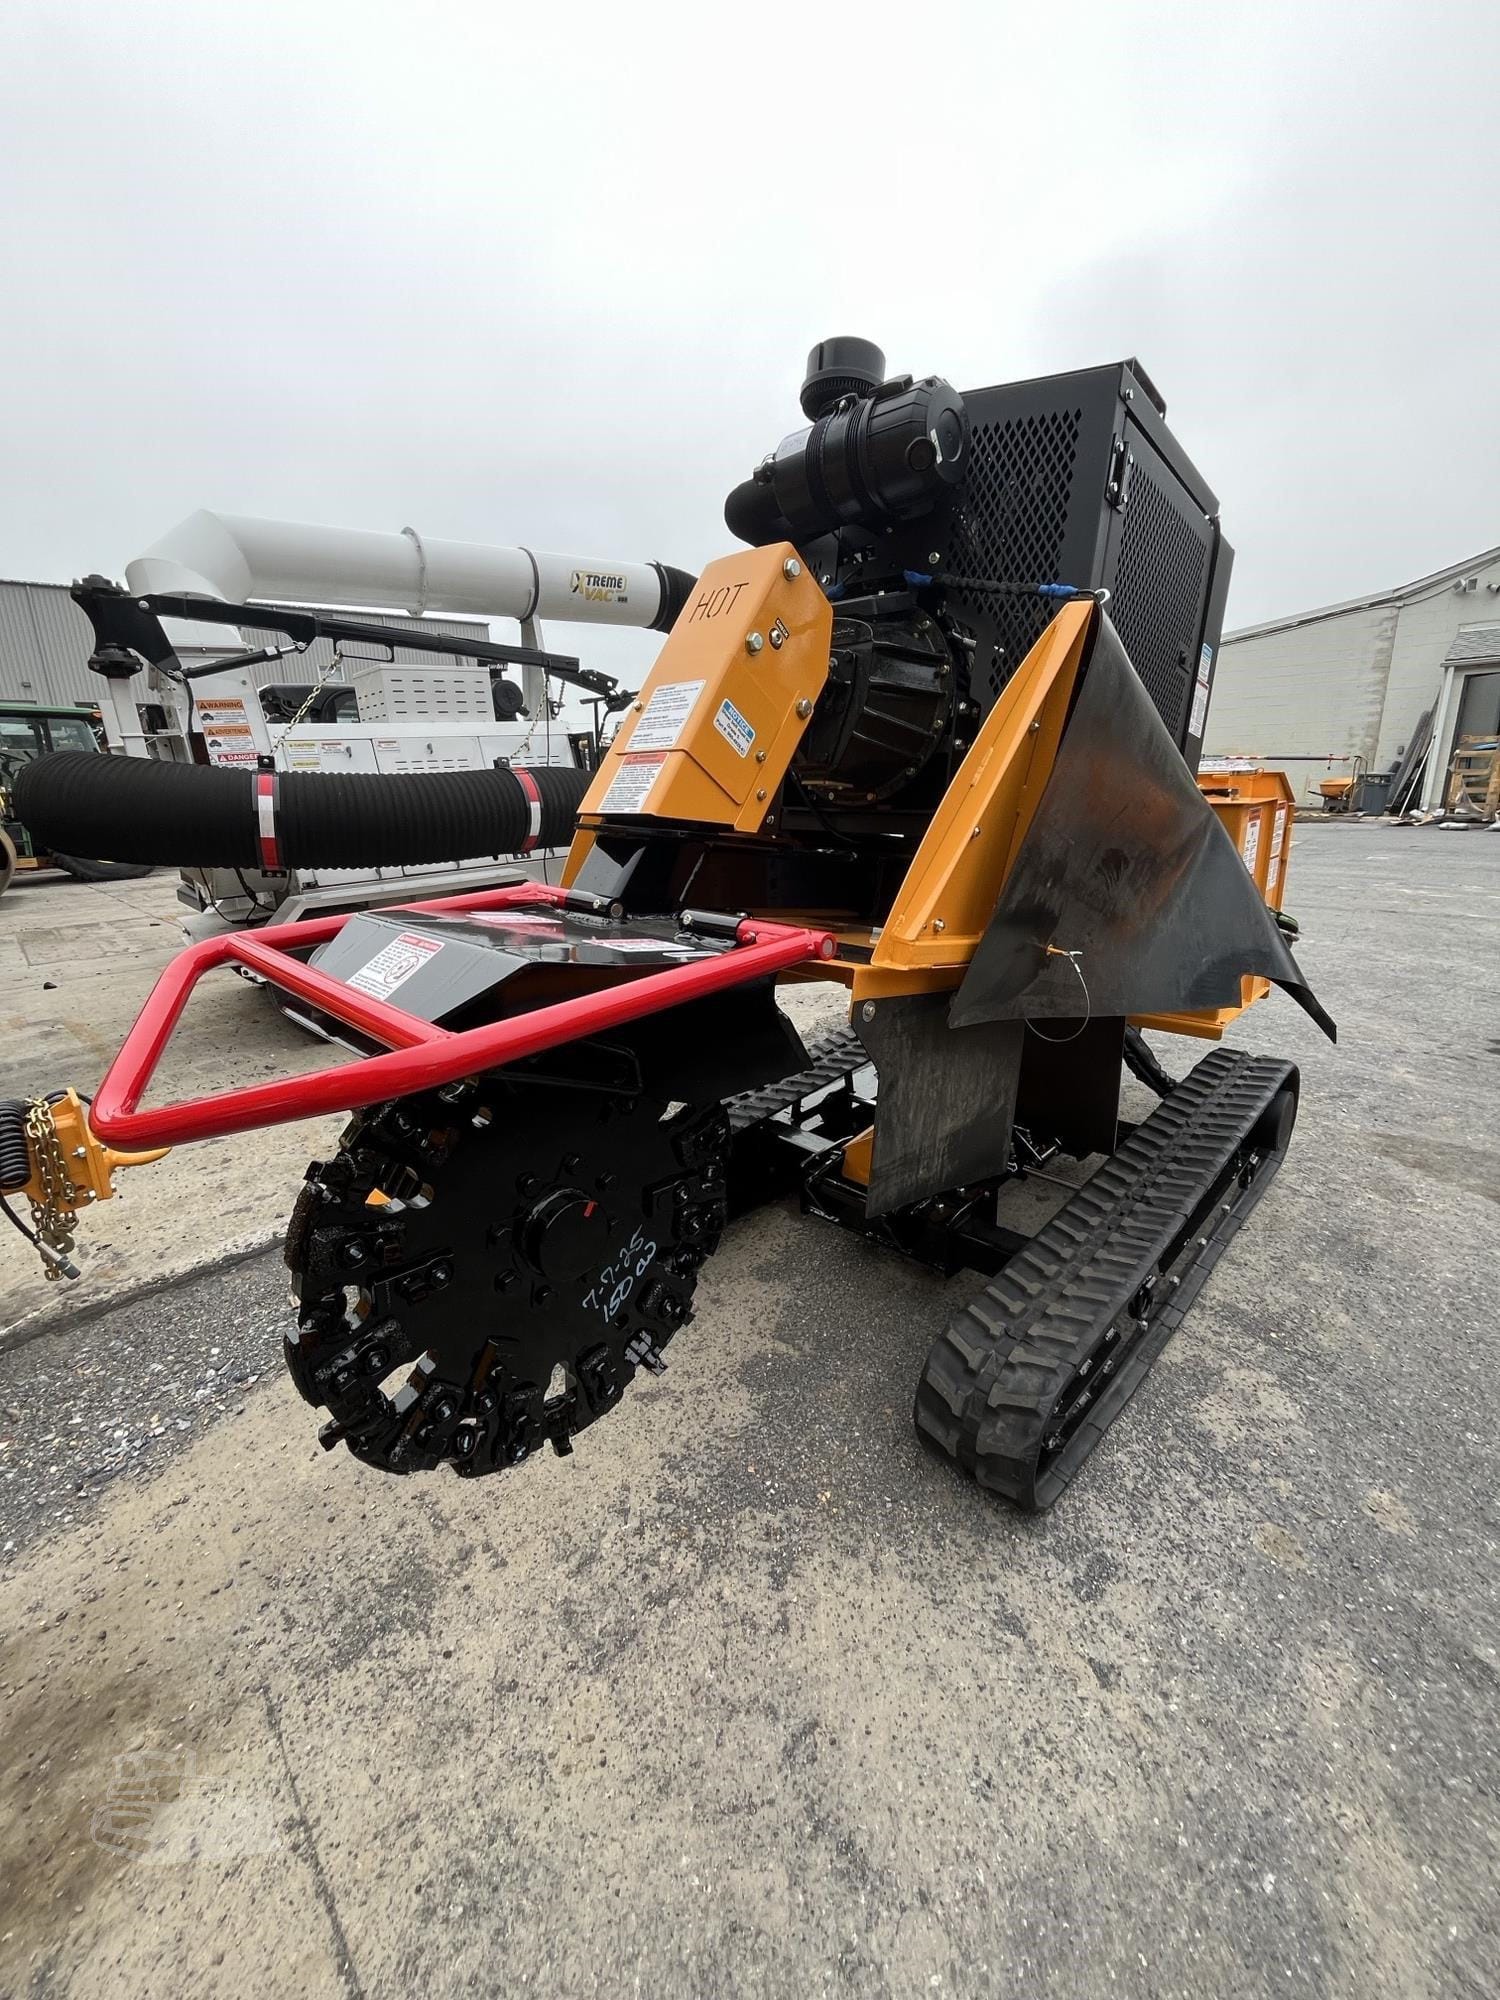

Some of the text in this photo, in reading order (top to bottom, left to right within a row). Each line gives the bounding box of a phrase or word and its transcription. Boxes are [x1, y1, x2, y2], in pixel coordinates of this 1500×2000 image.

[572, 572, 623, 593] XTREME
[586, 588, 612, 601] VAC
[689, 582, 750, 623] HOT
[728, 705, 751, 734] NOTICE
[582, 1223, 644, 1310] 7-7-25
